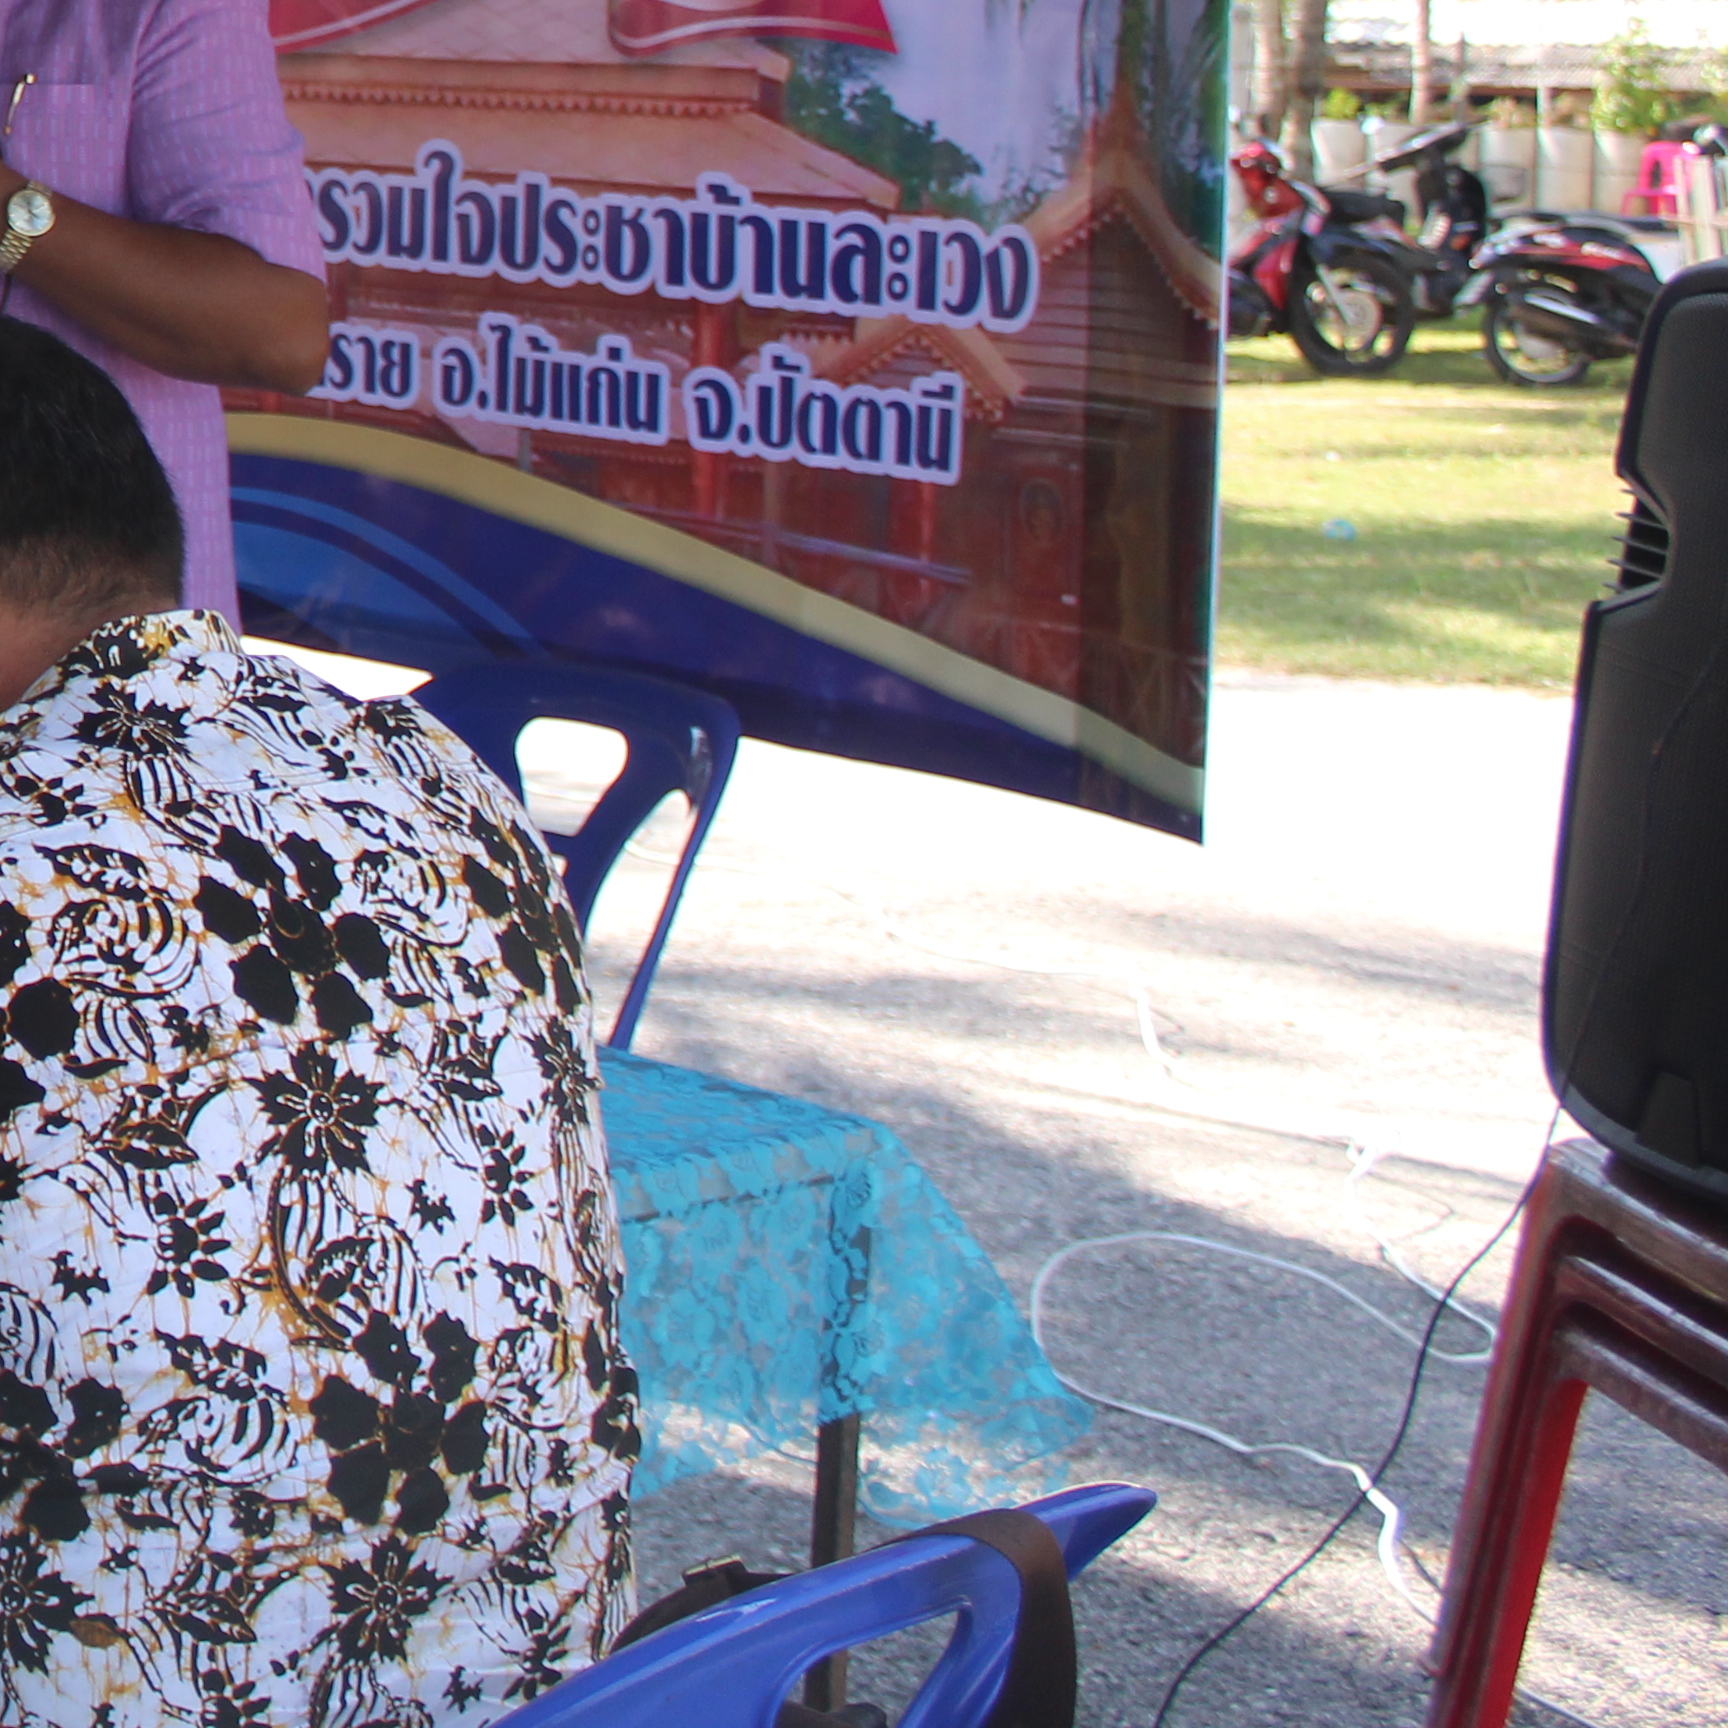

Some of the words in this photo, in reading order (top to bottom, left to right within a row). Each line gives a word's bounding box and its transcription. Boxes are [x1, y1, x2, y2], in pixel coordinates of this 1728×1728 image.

[304, 151, 1030, 320] รวมใจประชาบ้านละเวง
[319, 333, 413, 399] ราย
[440, 324, 662, 435] อ.ไม้แก่น
[692, 353, 955, 473] จ.ปัตตานี
